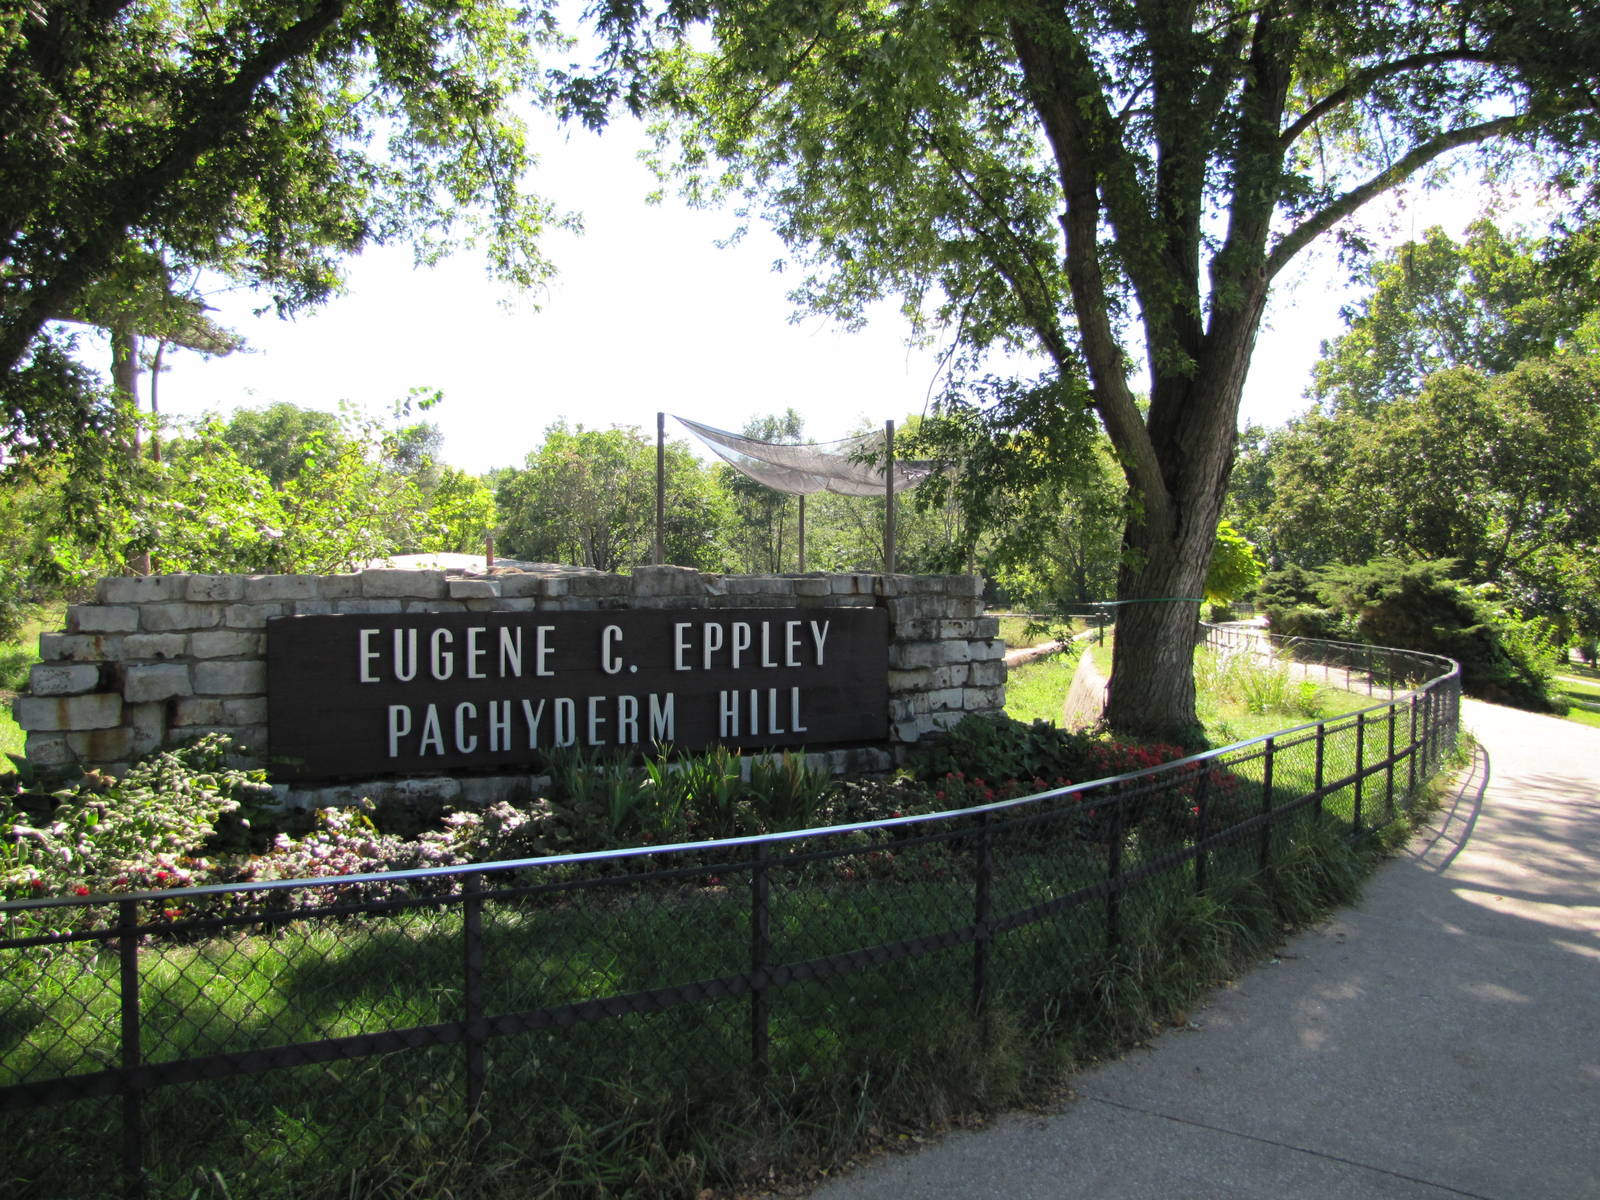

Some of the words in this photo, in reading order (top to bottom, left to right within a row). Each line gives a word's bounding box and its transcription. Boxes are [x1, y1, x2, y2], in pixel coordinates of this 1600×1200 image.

[359, 625, 556, 683] EUGENE
[602, 624, 639, 674] C.
[675, 619, 830, 671] EPPLEY
[388, 692, 676, 758] PACHYDERM
[720, 686, 808, 738] HILL
